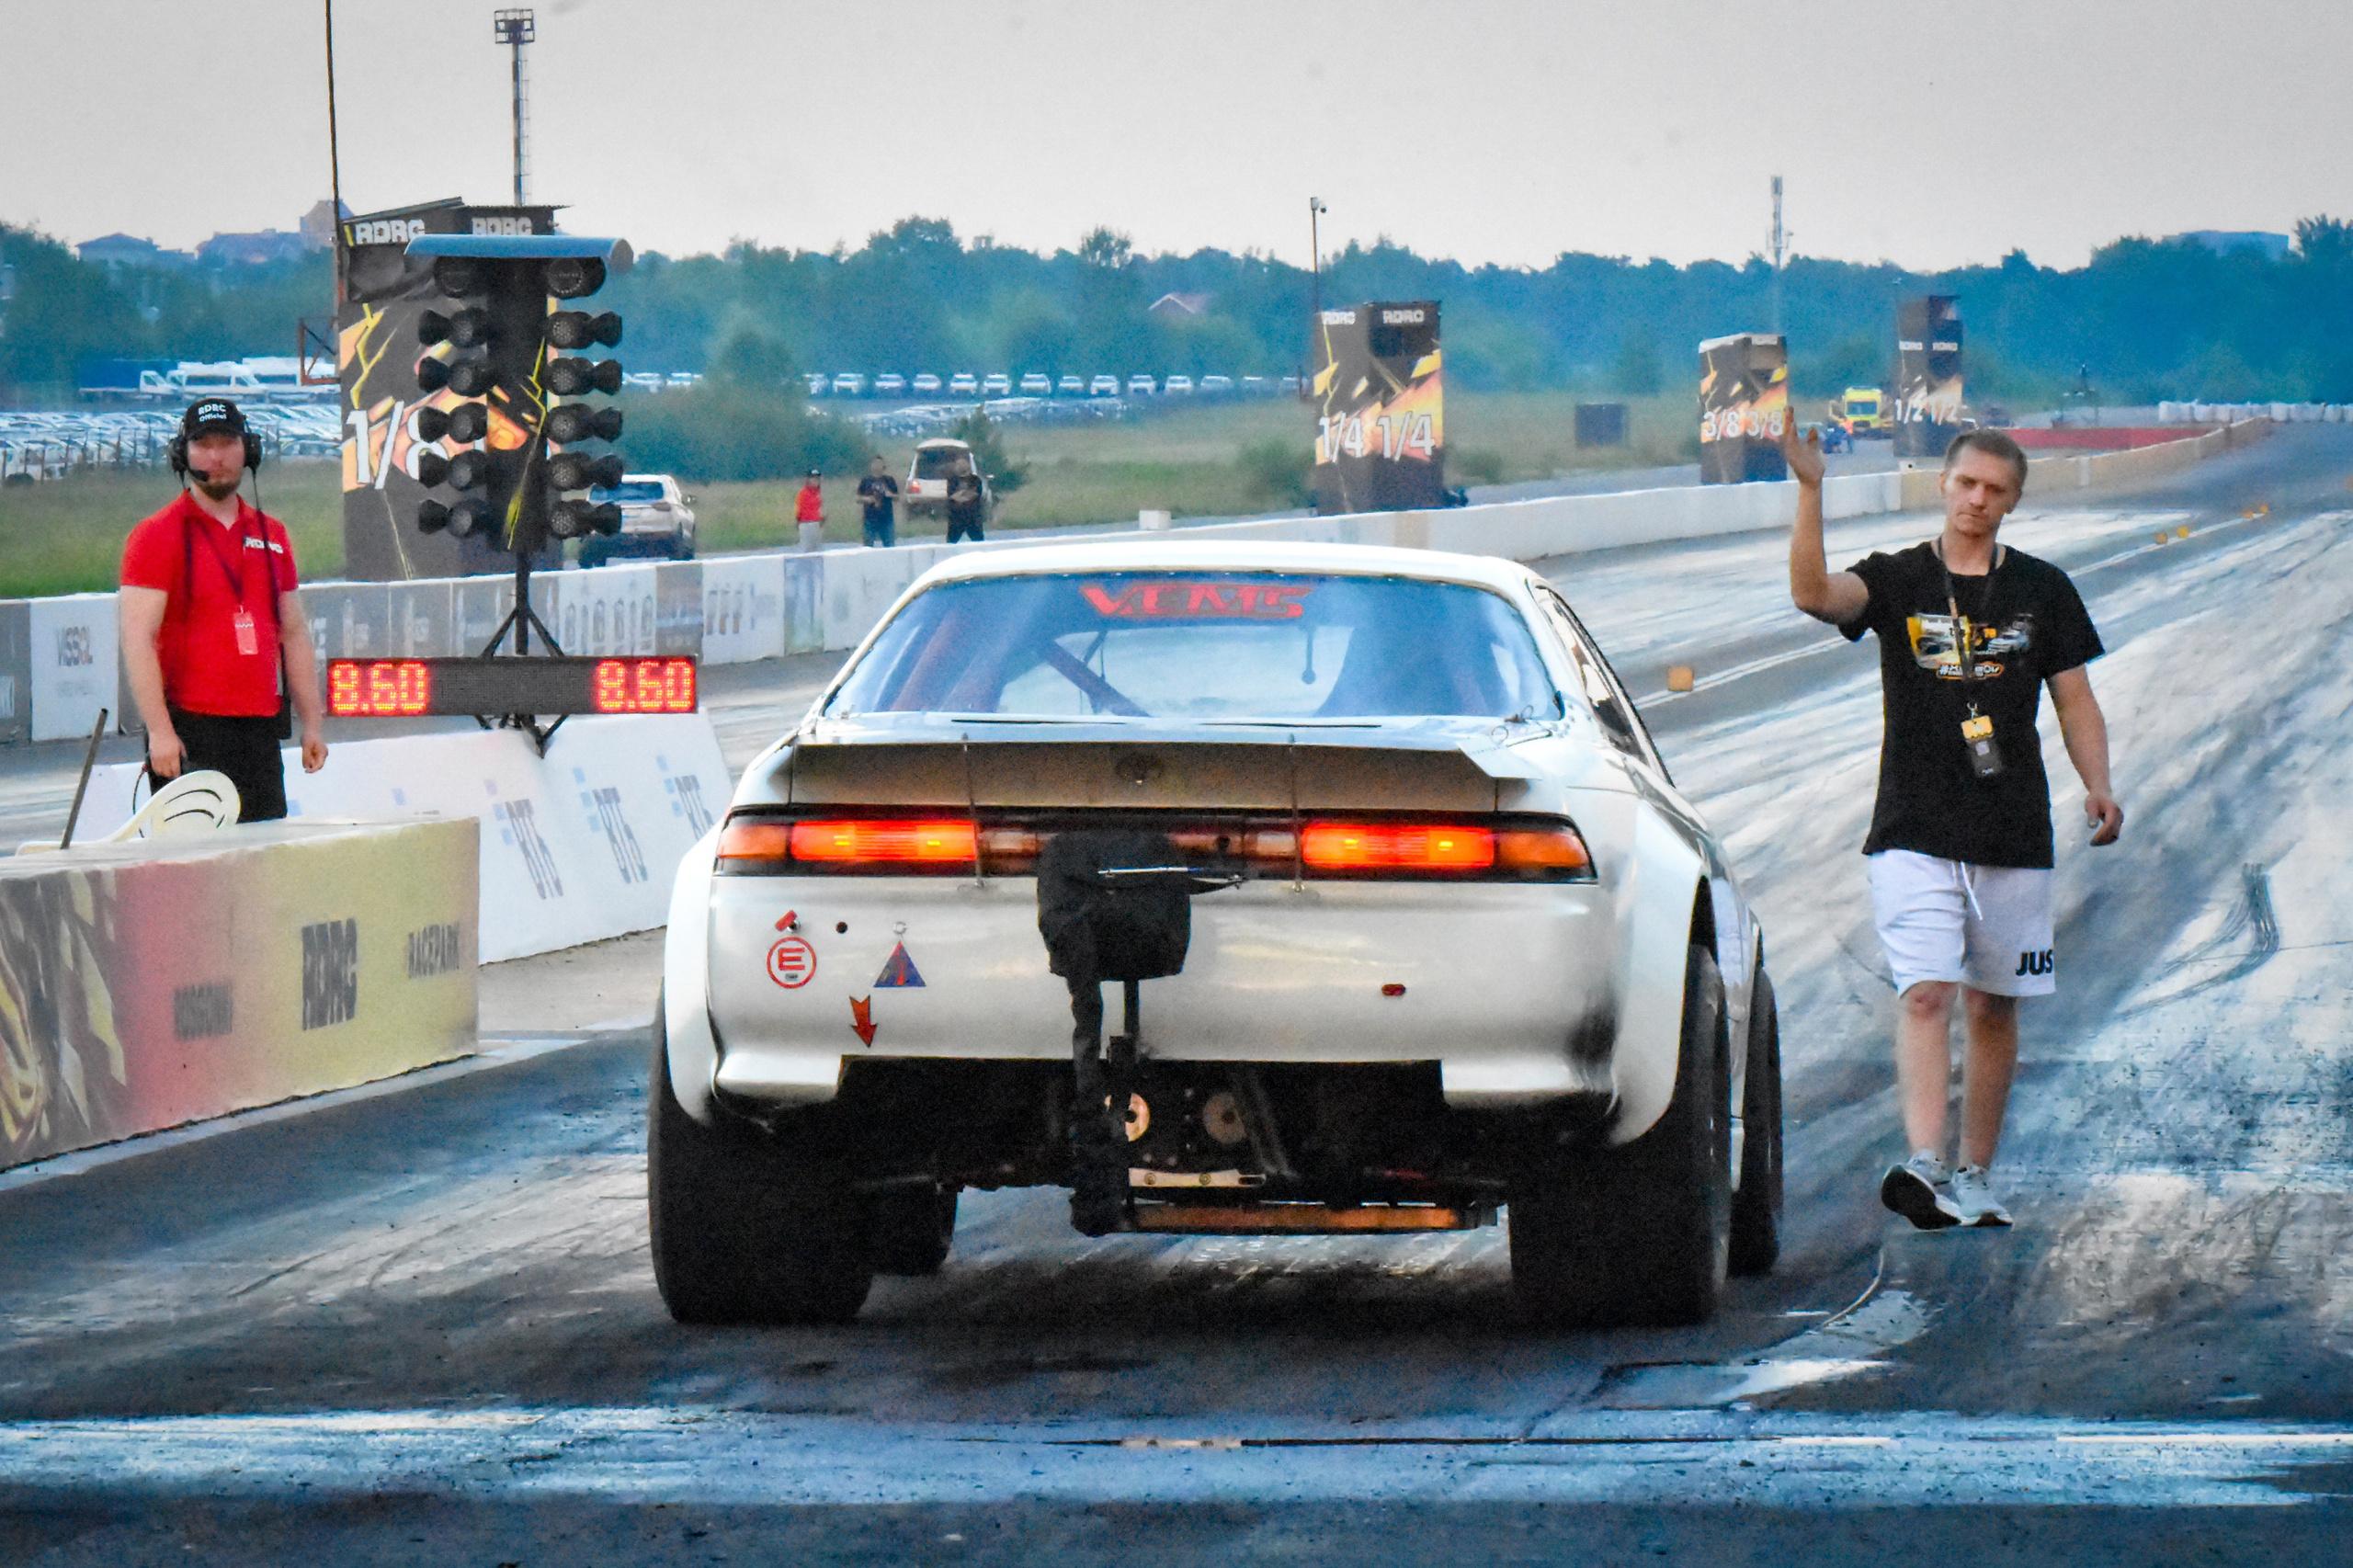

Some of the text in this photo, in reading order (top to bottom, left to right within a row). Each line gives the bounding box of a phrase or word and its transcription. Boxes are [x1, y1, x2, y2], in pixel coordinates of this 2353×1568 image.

[356, 220, 425, 244] RDRC
[198, 403, 226, 415] RDRC
[1703, 409, 1741, 441] 3/8
[1746, 410, 1783, 439] 3/8
[1319, 412, 1364, 463] 1/4
[1376, 411, 1436, 462] 1/4
[332, 662, 427, 712] 8.60
[597, 660, 693, 710] 8.60
[301, 917, 357, 1031] RDRC
[778, 947, 806, 971] E
